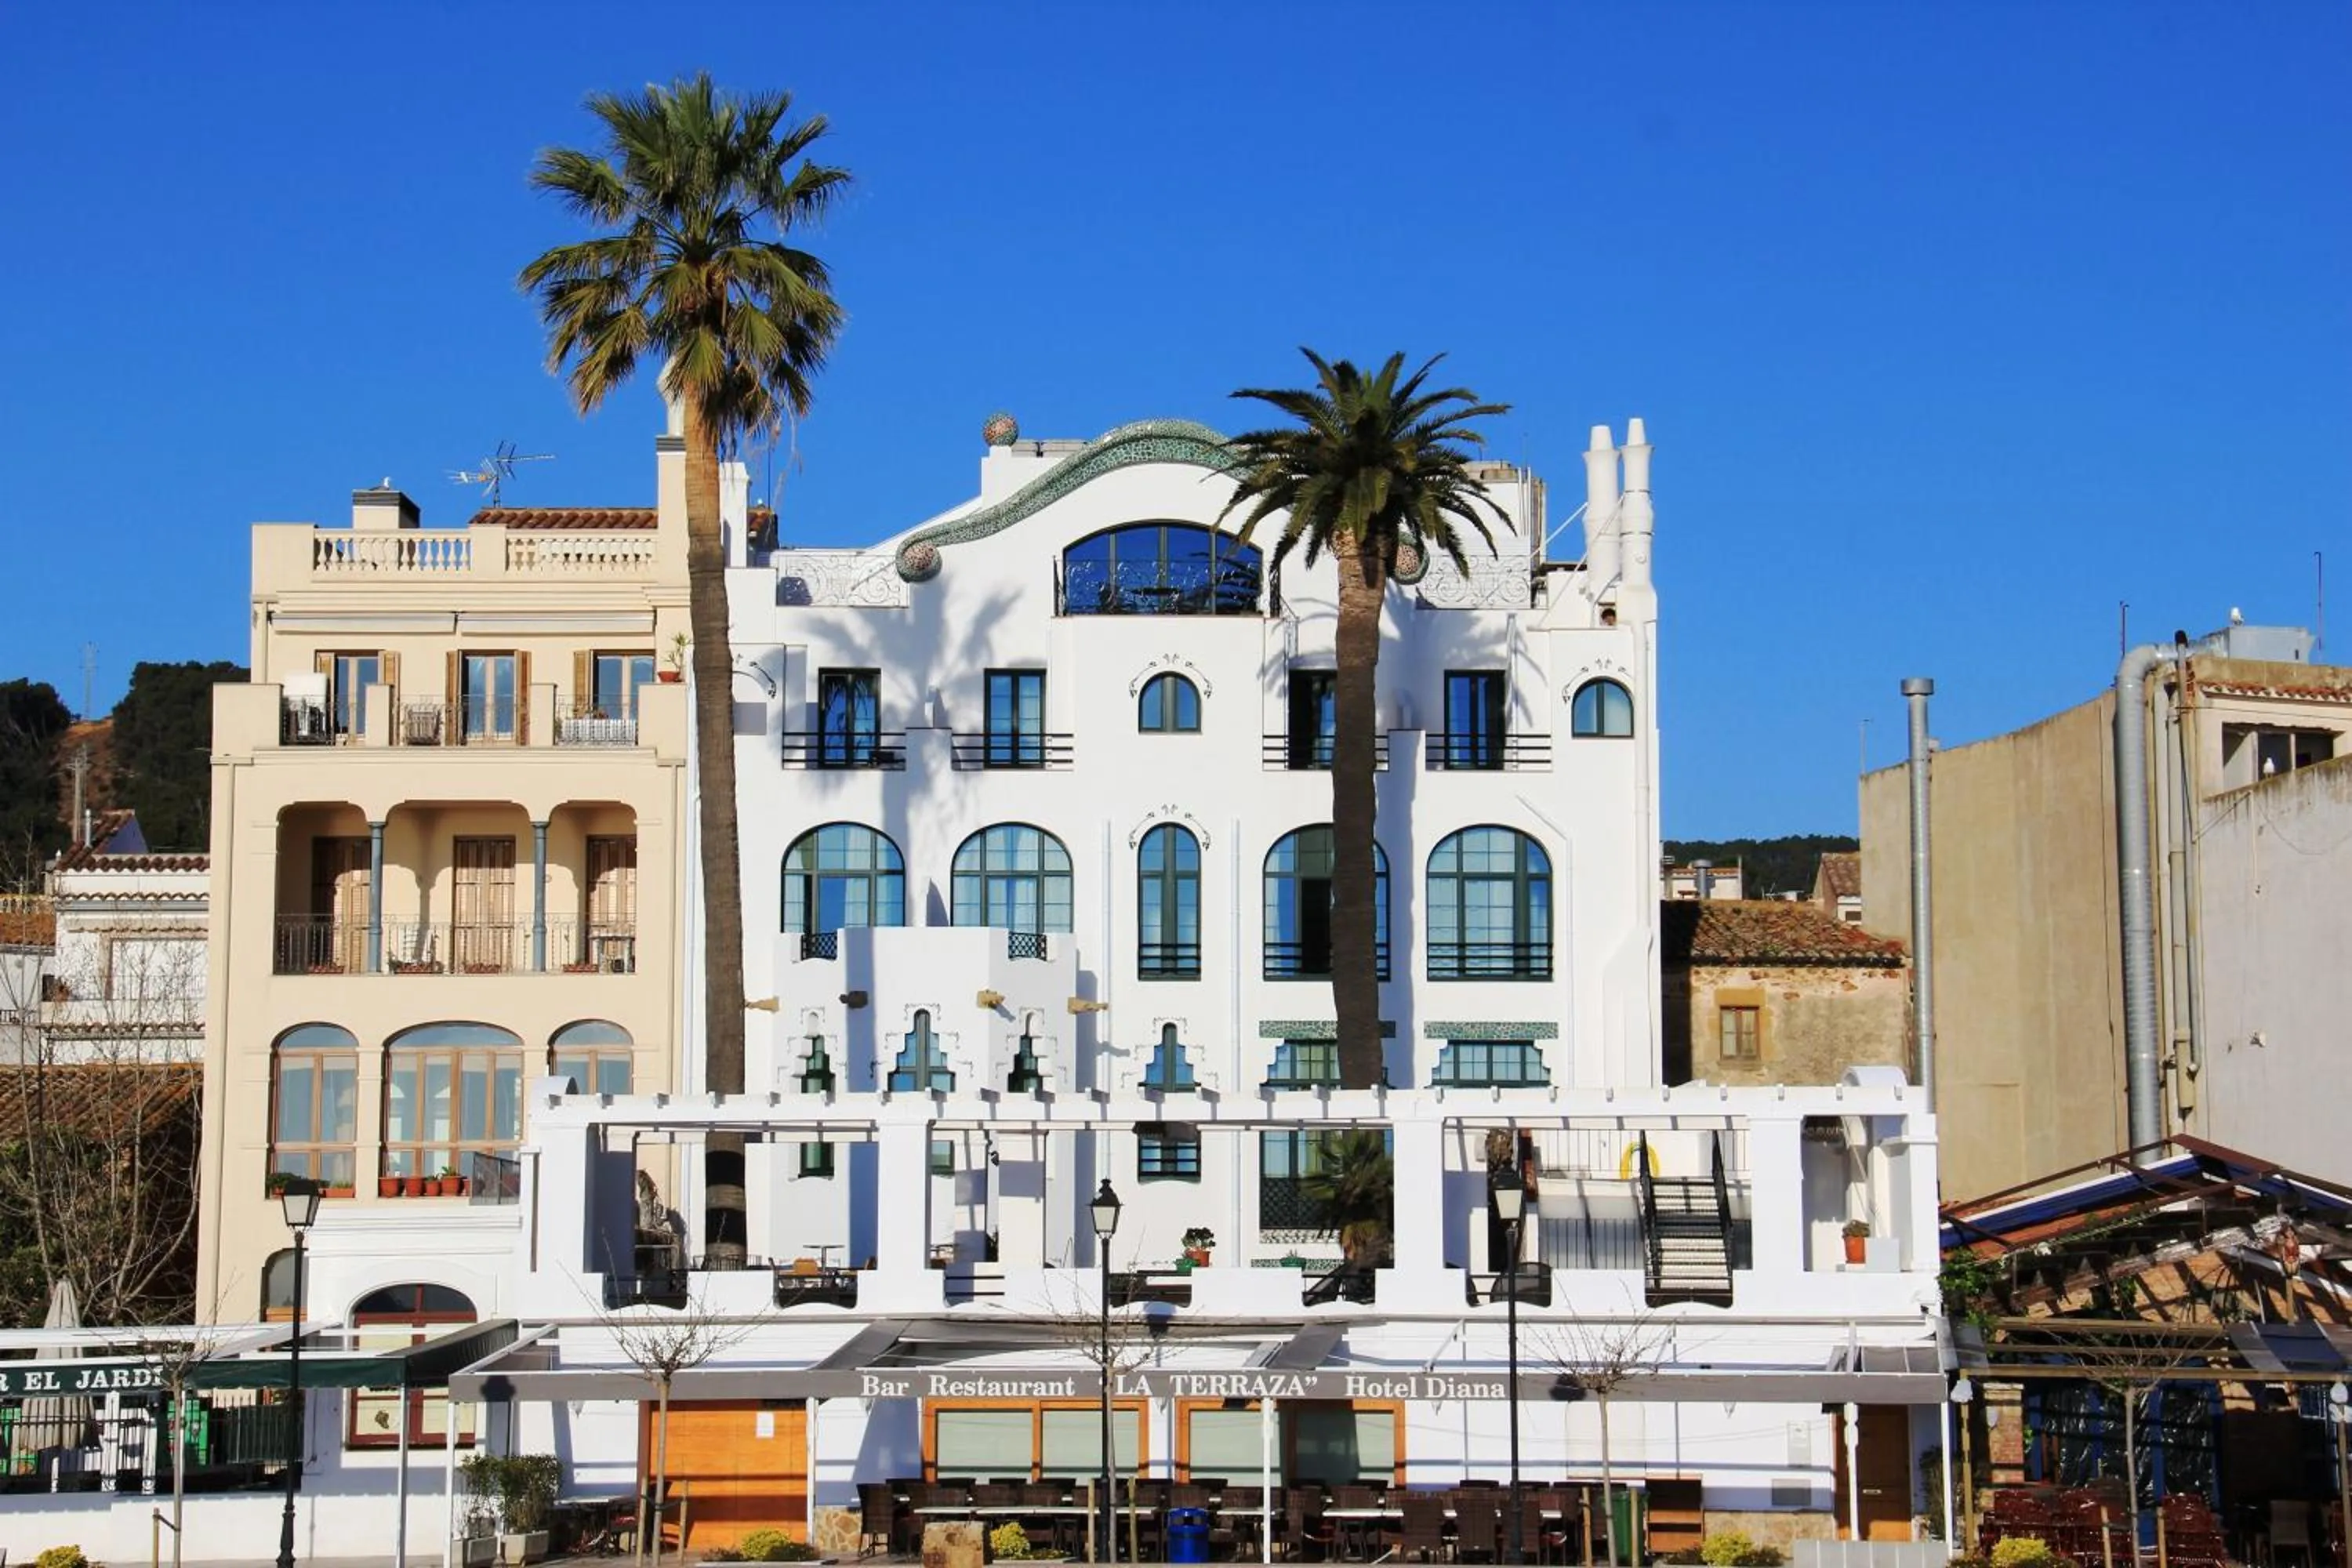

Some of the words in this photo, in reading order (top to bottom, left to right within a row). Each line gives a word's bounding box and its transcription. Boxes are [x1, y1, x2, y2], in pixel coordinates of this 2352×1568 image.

[24, 1371, 60, 1390] EL
[861, 1375, 909, 1396] Bar
[928, 1374, 1076, 1396] Restaurant
[1345, 1375, 1417, 1398] Hotel
[1425, 1377, 1505, 1398] Diana
